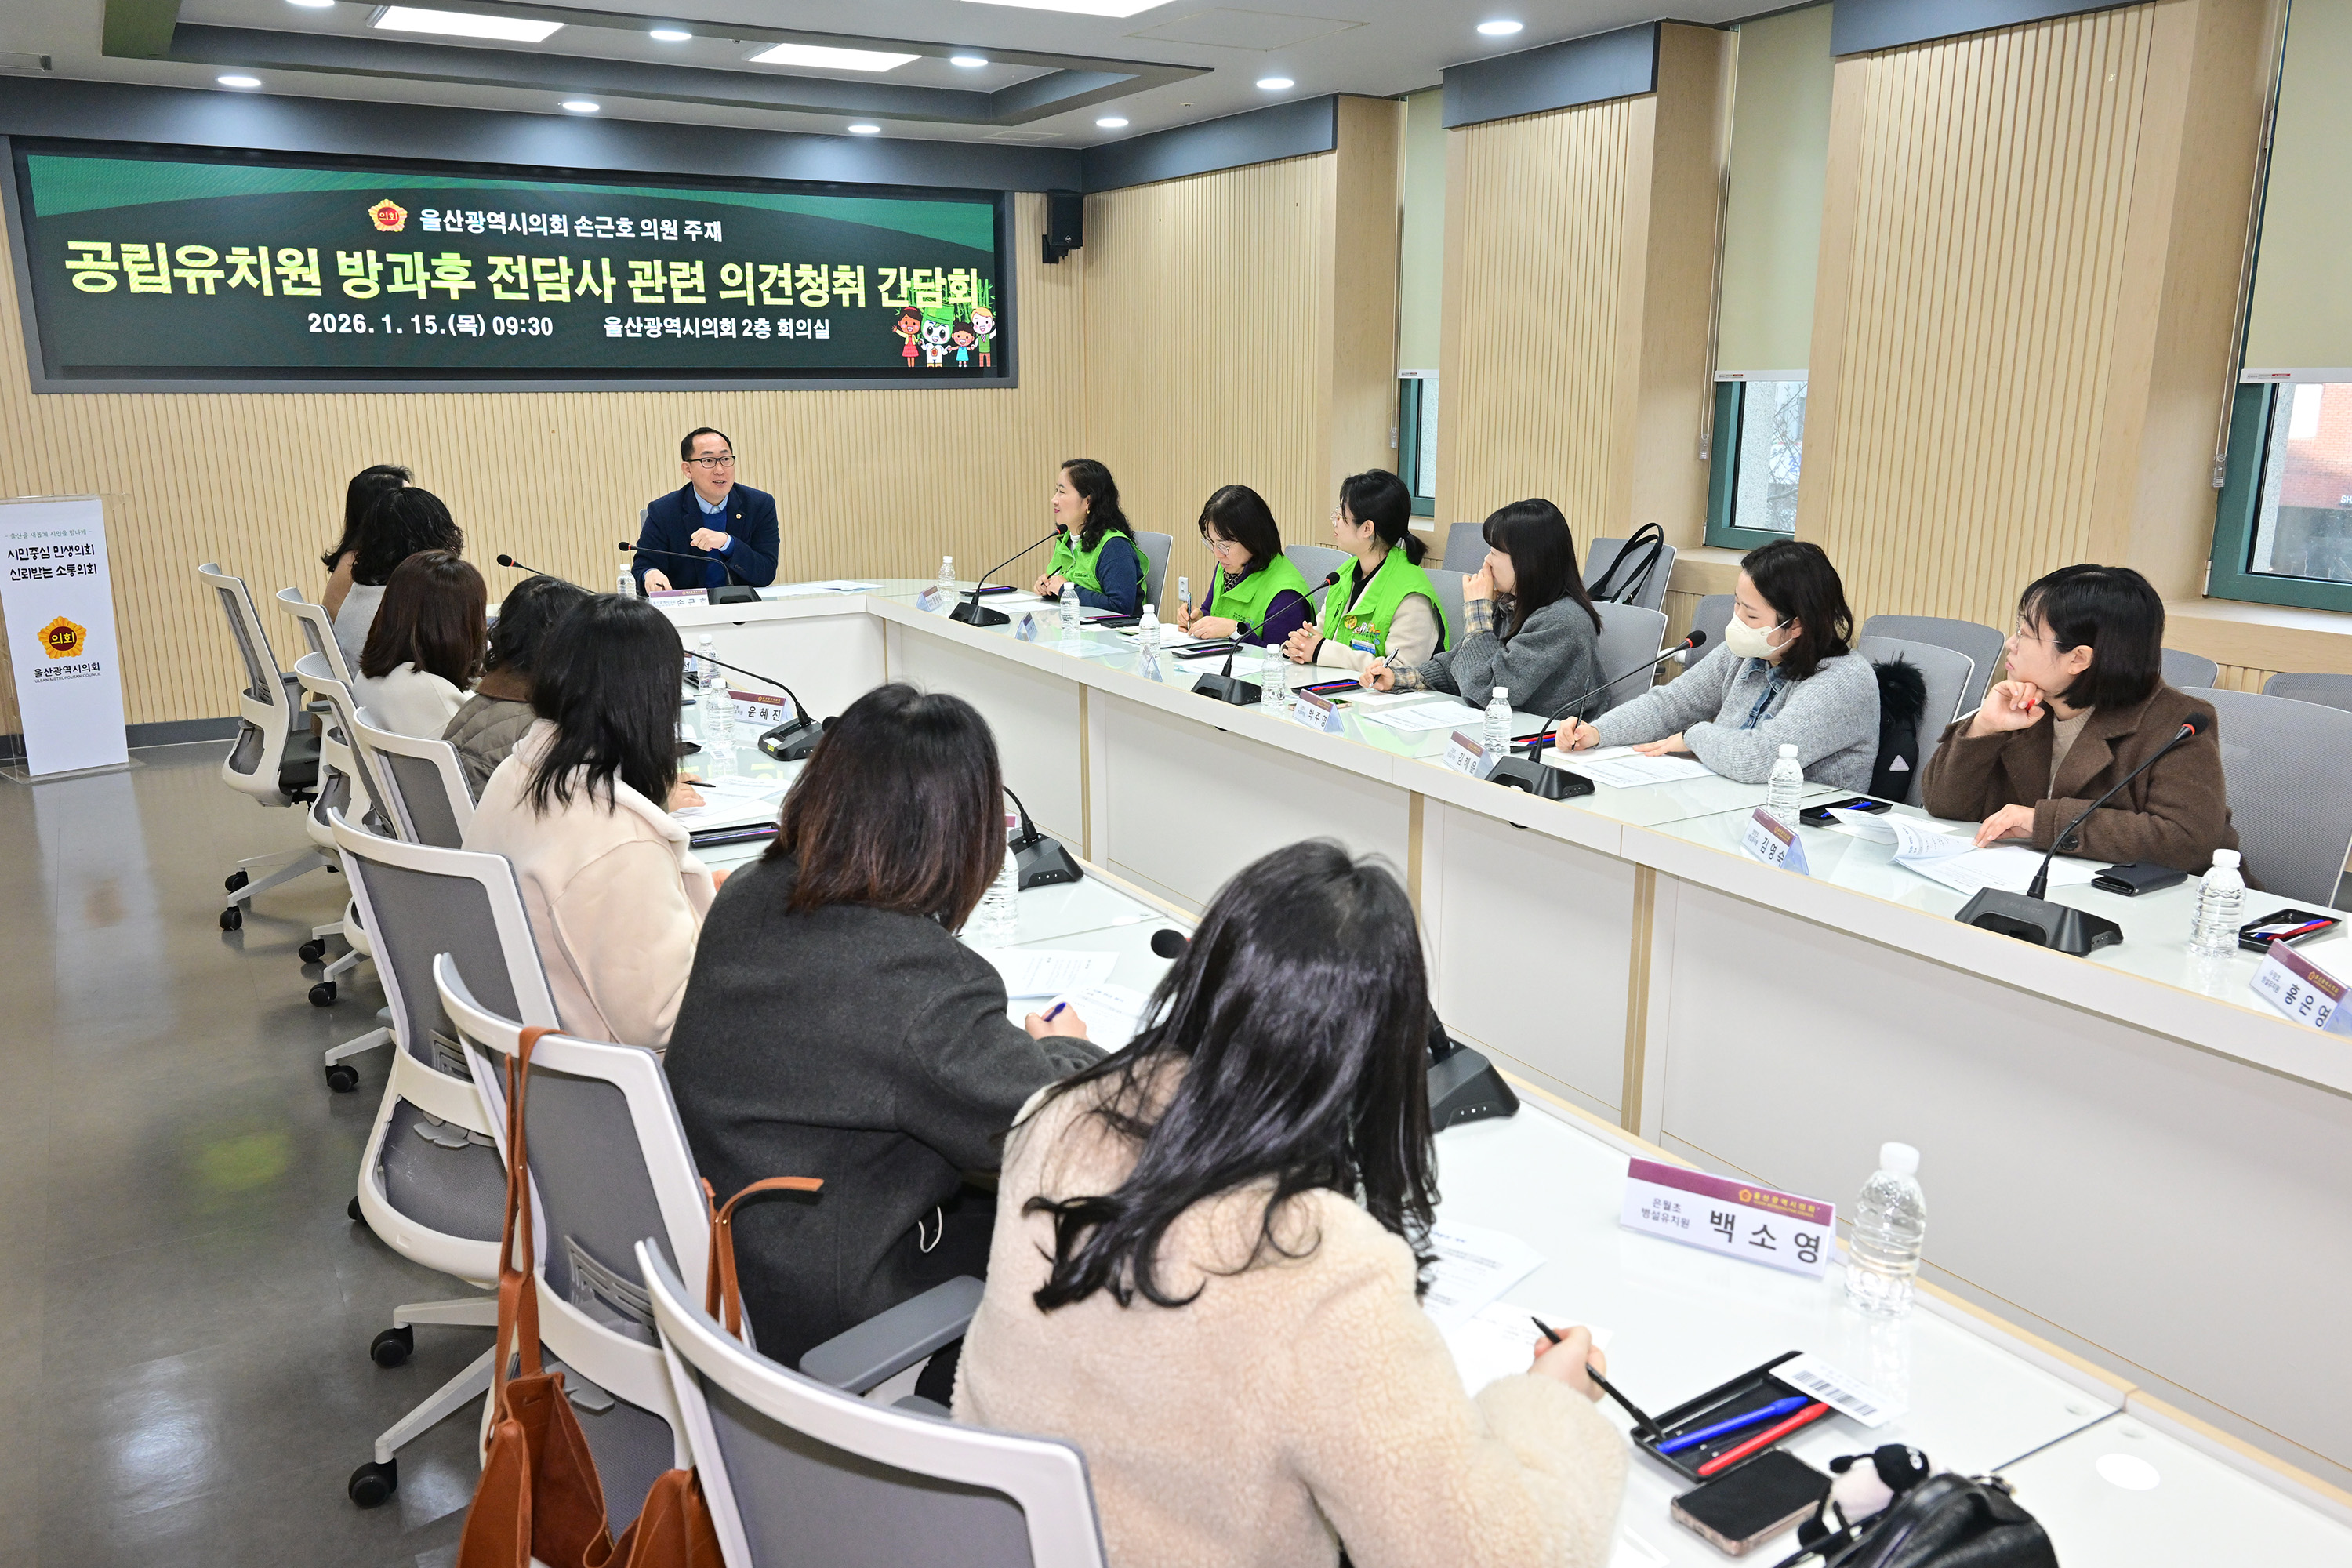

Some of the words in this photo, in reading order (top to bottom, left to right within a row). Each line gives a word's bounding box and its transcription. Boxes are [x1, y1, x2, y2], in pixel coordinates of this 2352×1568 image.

[379, 212, 398, 221] 의회
[419, 209, 569, 238] 울산광역시의회
[573, 215, 636, 238] 손근호
[640, 218, 679, 241] 의원
[684, 220, 723, 243] 주재
[64, 241, 322, 296] 공립유치원
[336, 249, 477, 301] 방과후
[487, 254, 616, 303] 전담사
[627, 259, 707, 304] 관련
[719, 261, 866, 308] 의견청취
[877, 266, 979, 309] 간담회
[308, 312, 375, 334] 2026.
[381, 314, 403, 334] 1.
[410, 313, 485, 337] 15.(목)
[492, 315, 554, 336] 09:30
[603, 316, 737, 339] 울산광역시의회
[742, 318, 772, 339] 2층
[777, 318, 831, 340] 회의실
[8, 546, 51, 561] 시민중심
[53, 543, 95, 559] 민생의회
[10, 567, 53, 582] 신뢰받는
[56, 563, 98, 578] 소통의회
[51, 631, 75, 644] 의회
[34, 662, 100, 678] 울산광역시의회
